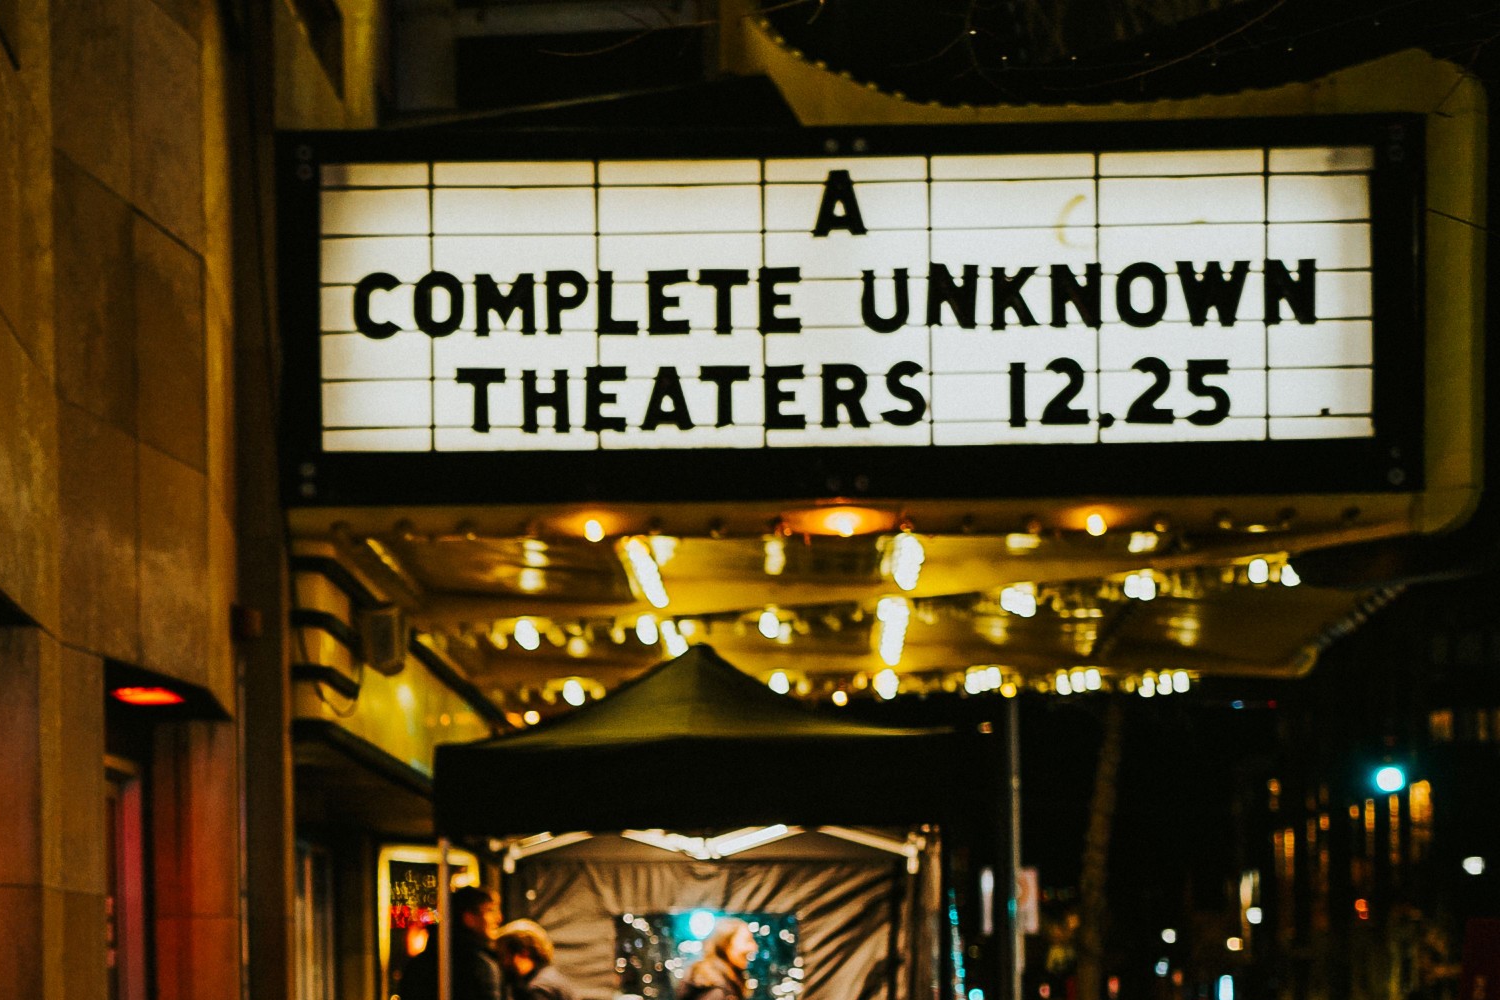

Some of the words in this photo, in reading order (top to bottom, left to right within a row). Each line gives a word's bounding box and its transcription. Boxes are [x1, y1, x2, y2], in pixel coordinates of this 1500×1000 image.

[813, 170, 868, 237] A
[352, 266, 802, 339] COMPLETE
[860, 258, 1318, 333] UNKNOWN
[456, 361, 928, 433] THEATERS
[1008, 358, 1231, 430] 12.25
